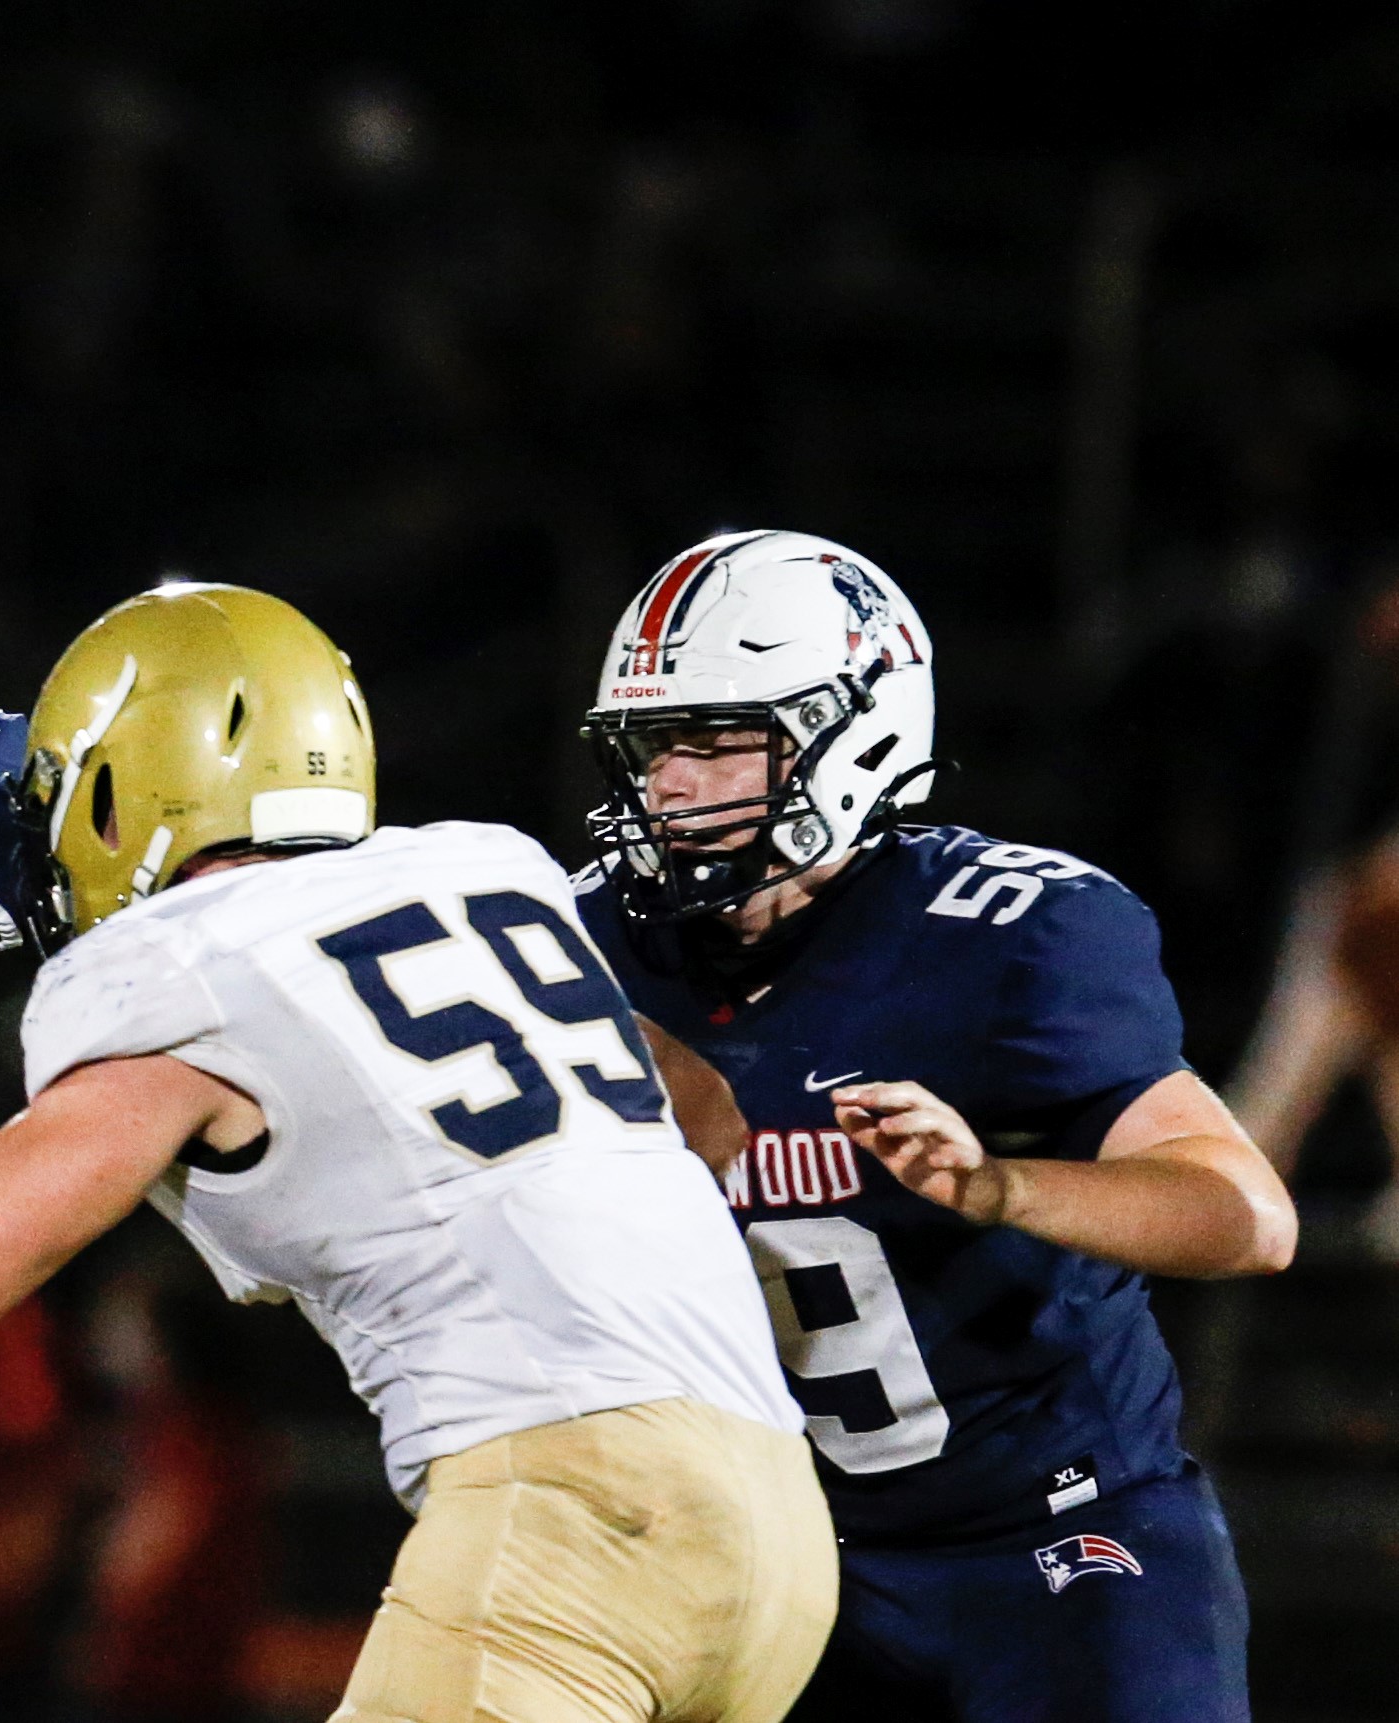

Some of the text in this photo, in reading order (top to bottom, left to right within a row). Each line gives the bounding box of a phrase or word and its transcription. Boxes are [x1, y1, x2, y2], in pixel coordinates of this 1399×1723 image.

[925, 843, 1094, 926] 59
[308, 887, 671, 1166] 59
[724, 1129, 863, 1208] WOOD
[746, 1216, 952, 1475] 9
[1054, 1467, 1084, 1488] XL
